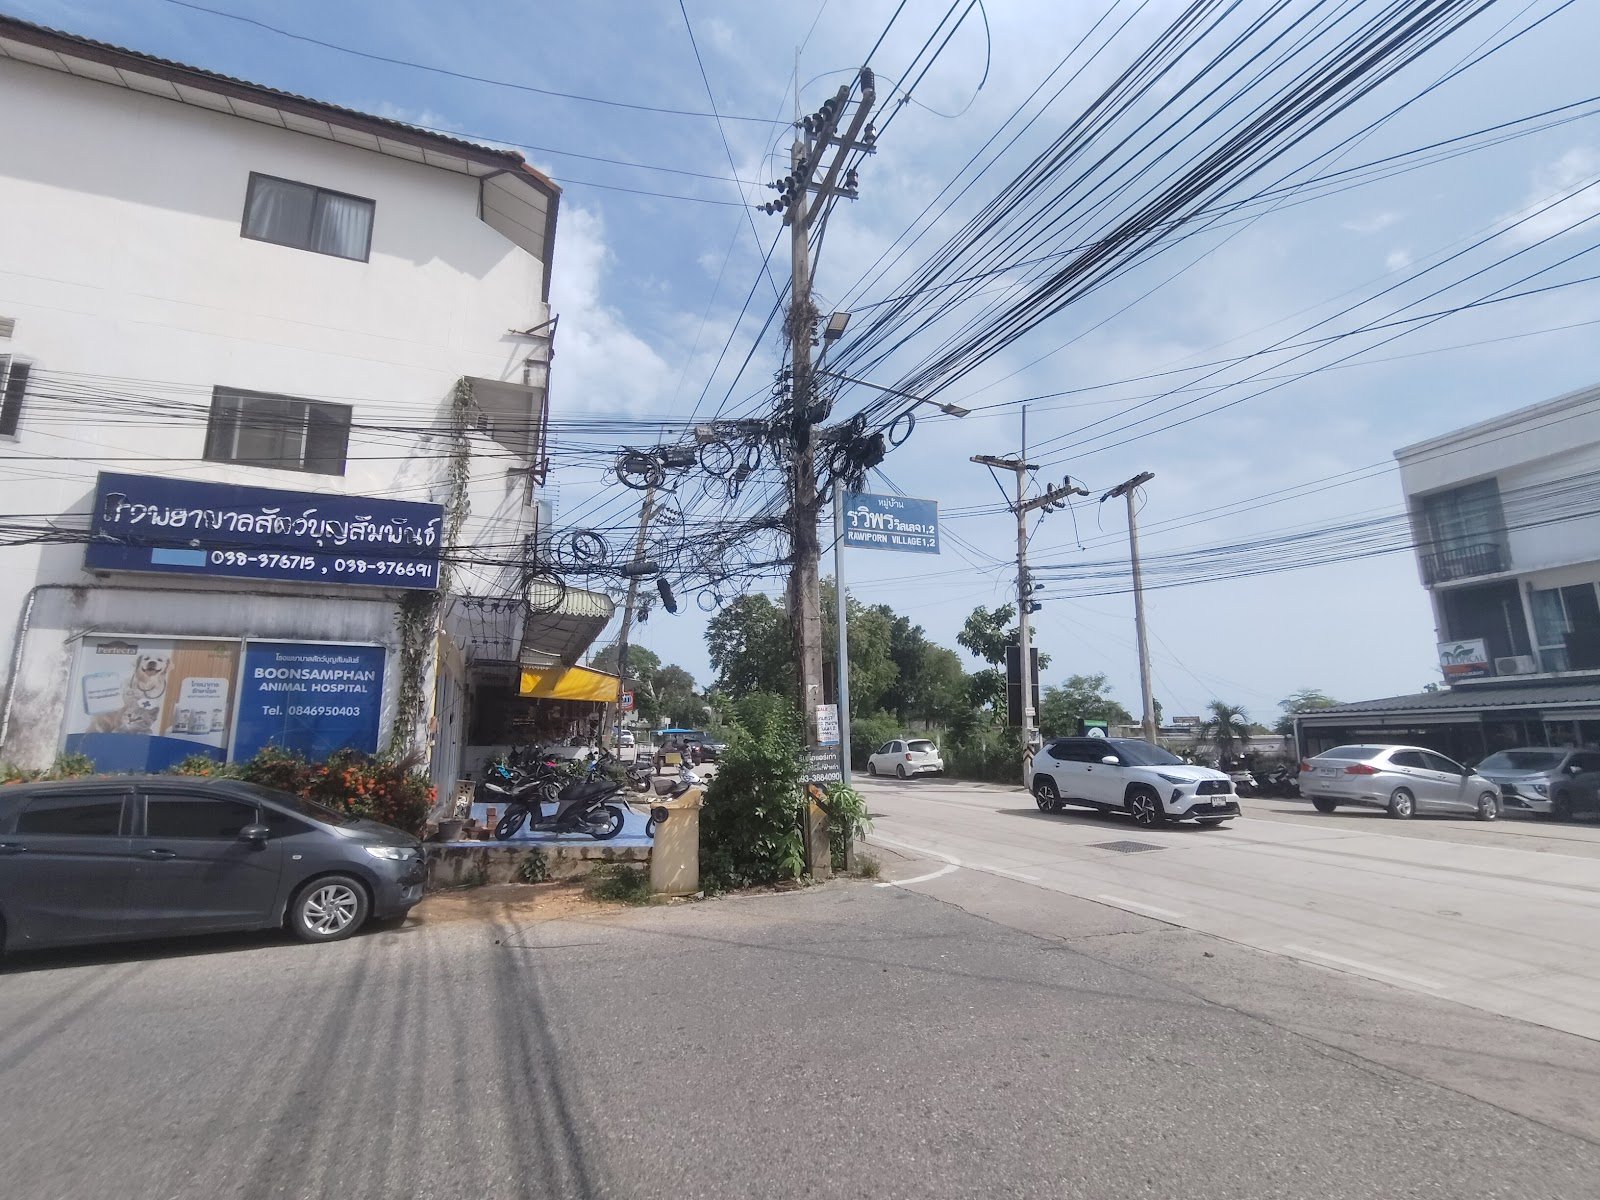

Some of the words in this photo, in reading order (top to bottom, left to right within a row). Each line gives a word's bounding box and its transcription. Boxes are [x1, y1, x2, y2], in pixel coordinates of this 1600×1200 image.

[878, 498, 904, 510] หมู่บ้าน
[848, 531, 888, 543] RAWIPORN
[334, 558, 432, 578] 038-376691
[254, 667, 376, 682] BOONSAMPHAN
[259, 682, 308, 692] ANIMAL
[311, 683, 368, 693] HOSPITAL
[262, 705, 283, 716] Tel.
[288, 705, 361, 717] 0846950403
